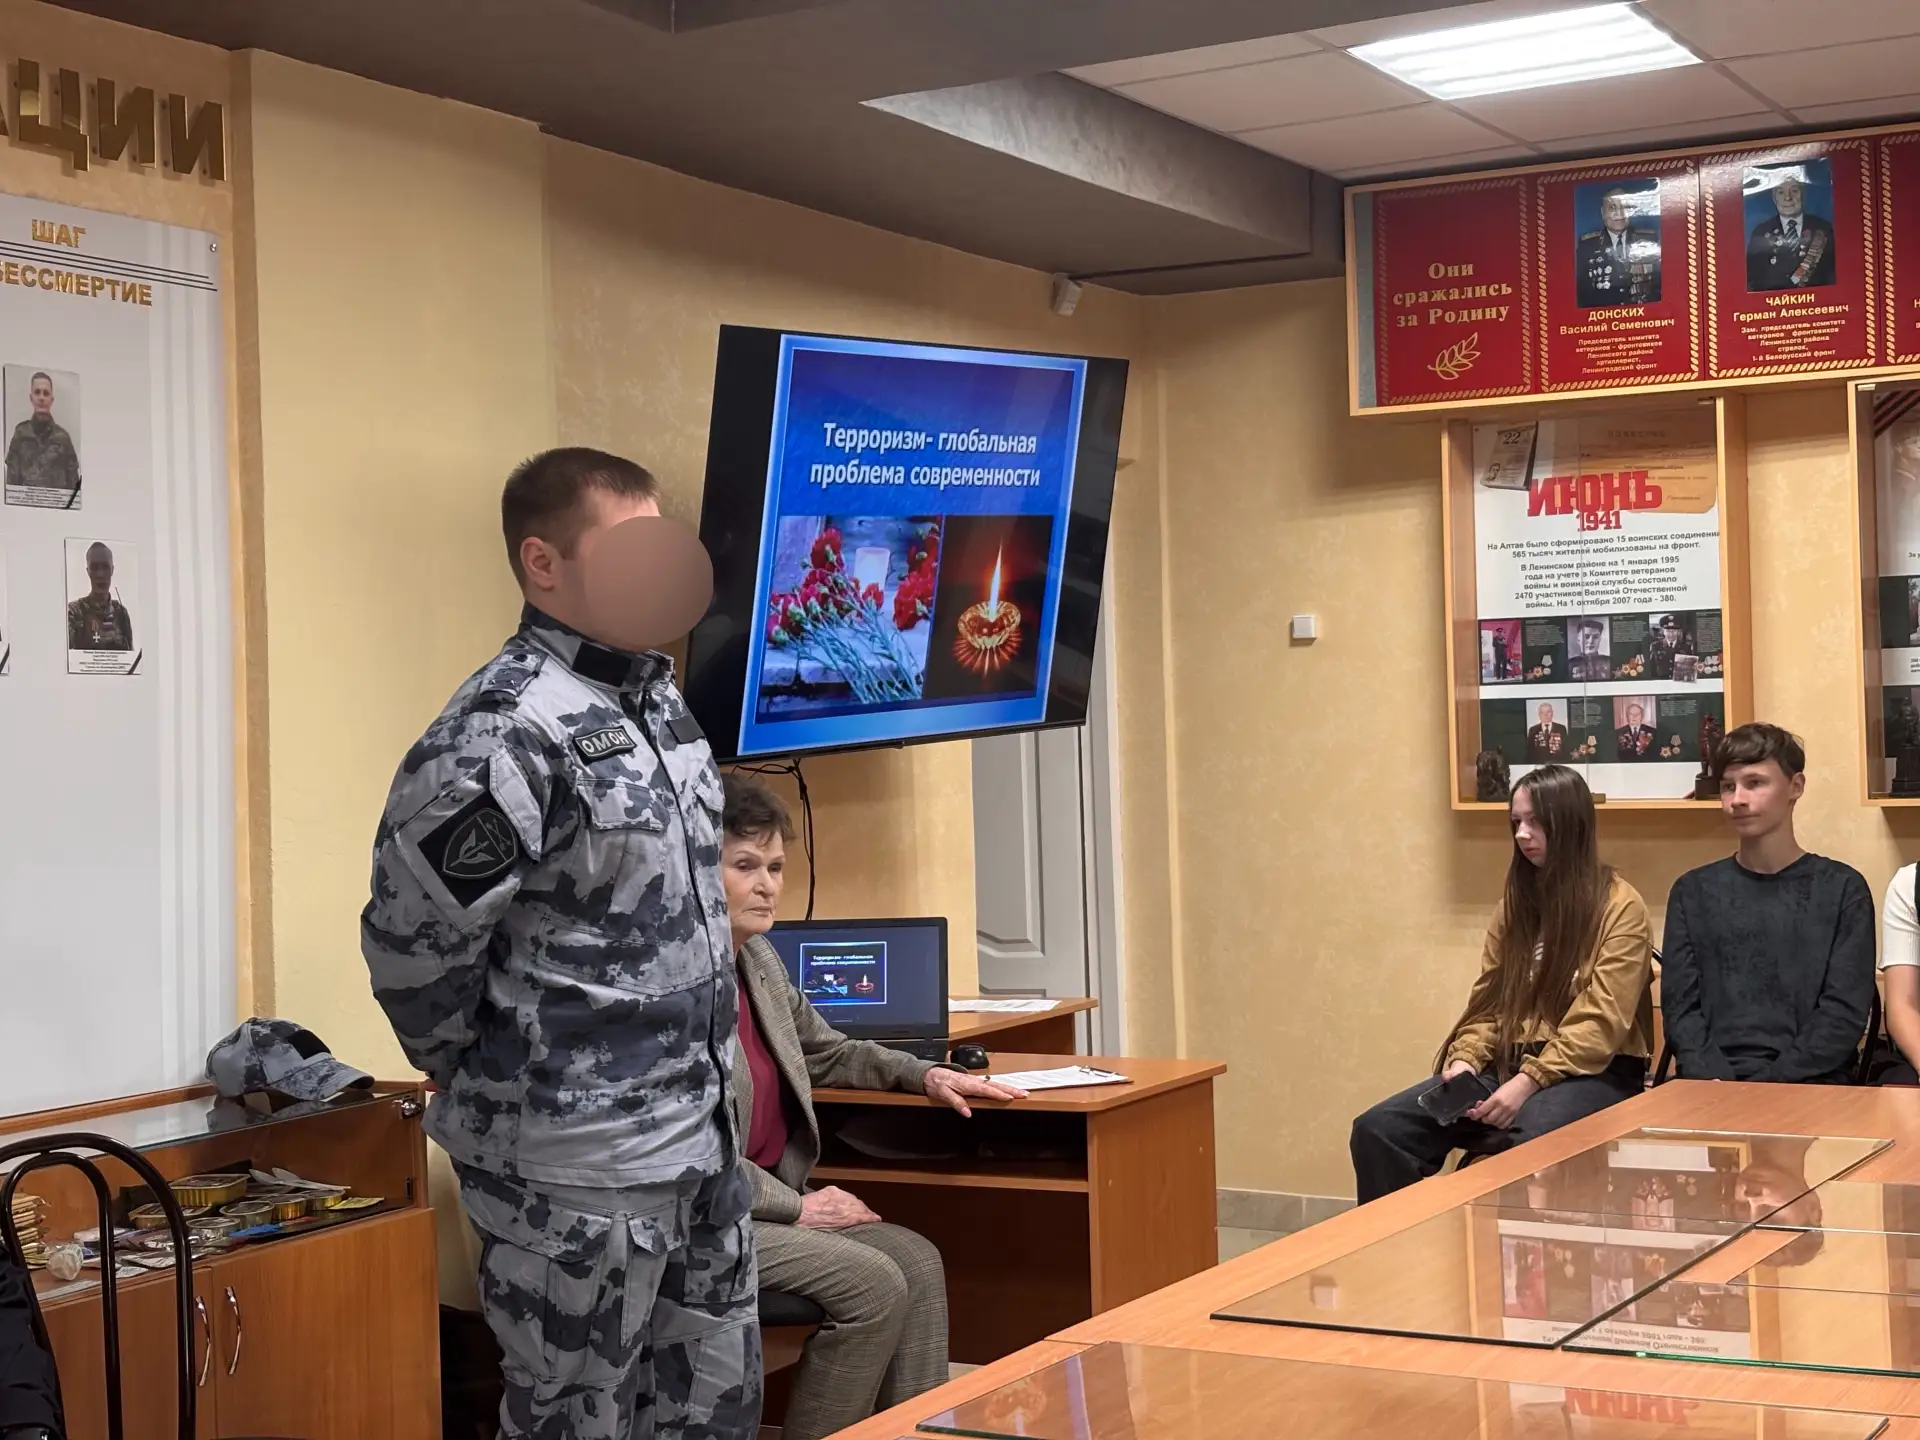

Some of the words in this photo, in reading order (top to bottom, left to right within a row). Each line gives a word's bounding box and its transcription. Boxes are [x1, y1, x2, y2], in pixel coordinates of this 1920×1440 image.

[0, 58, 227, 182] ЦИИ
[32, 219, 87, 248] ШАГ
[1428, 262, 1474, 279] Они
[0, 261, 152, 306] ЕССМЕРТИЕ
[1393, 283, 1513, 308] сражались
[1766, 293, 1815, 306] ЧАЙКИН
[1396, 314, 1419, 328] за
[1428, 306, 1510, 325] Родину
[1588, 307, 1645, 322] ДОНСКИХ
[1733, 310, 1776, 322] Герман
[1780, 304, 1849, 318] Алексеевич
[1560, 323, 1608, 335] Василий
[1611, 319, 1675, 331] Семенович
[1761, 323, 1811, 332] председатель
[1812, 319, 1846, 327] комитета
[1578, 337, 1627, 346] Председатель
[1747, 332, 1785, 340] ветеранов
[1792, 328, 1839, 337] фронтовиков
[1760, 338, 1802, 346] Ленинского
[1803, 335, 1830, 343] района
[1576, 345, 1611, 353] ветеранов
[1617, 341, 1663, 350] фронтовиков
[1587, 351, 1627, 359] Ленинского
[1765, 351, 1812, 361] Белорусский
[1813, 350, 1836, 358] фронт
[1581, 365, 1634, 374] Ленинградский
[1635, 363, 1657, 371] фронт
[823, 422, 934, 454] Терроризм-
[938, 428, 1037, 454] глобальная
[1502, 432, 1521, 445] 22
[810, 458, 905, 489] проблема
[910, 466, 1041, 490] современности
[1527, 470, 1662, 517] ИЮНЬ
[1576, 510, 1622, 532] 1941
[1499, 542, 1524, 550] Алтае
[1526, 540, 1549, 548] было
[1550, 538, 1614, 547] сформировано
[1617, 535, 1626, 543] 15
[1628, 533, 1668, 542] воинских
[1555, 547, 1591, 556] жителей
[1593, 545, 1657, 554] мобилизованы
[1671, 541, 1701, 551] фронт.
[1528, 562, 1574, 571] Ленинском
[1576, 560, 1606, 570] районе
[1627, 558, 1658, 566] января
[1660, 555, 1680, 564] 1995
[1525, 573, 1543, 581] года
[1556, 572, 1580, 580] учете
[1589, 569, 1629, 577] Комитете
[1631, 567, 1676, 575] ветеранов
[1524, 582, 1551, 590] войны
[1560, 580, 1600, 588] воинской
[1601, 577, 1635, 587] службы
[1514, 592, 1533, 600] 2470
[1535, 591, 1583, 600] участников
[1584, 588, 1620, 597] Великой
[1622, 584, 1687, 594] Отечественной
[1525, 601, 1555, 609] войны.
[1570, 599, 1574, 607] 1
[1576, 598, 1610, 607] октября
[1612, 597, 1631, 605] 2007
[1633, 597, 1652, 605] года
[1659, 594, 1677, 602] 380.
[581, 731, 630, 753] ОМОН
